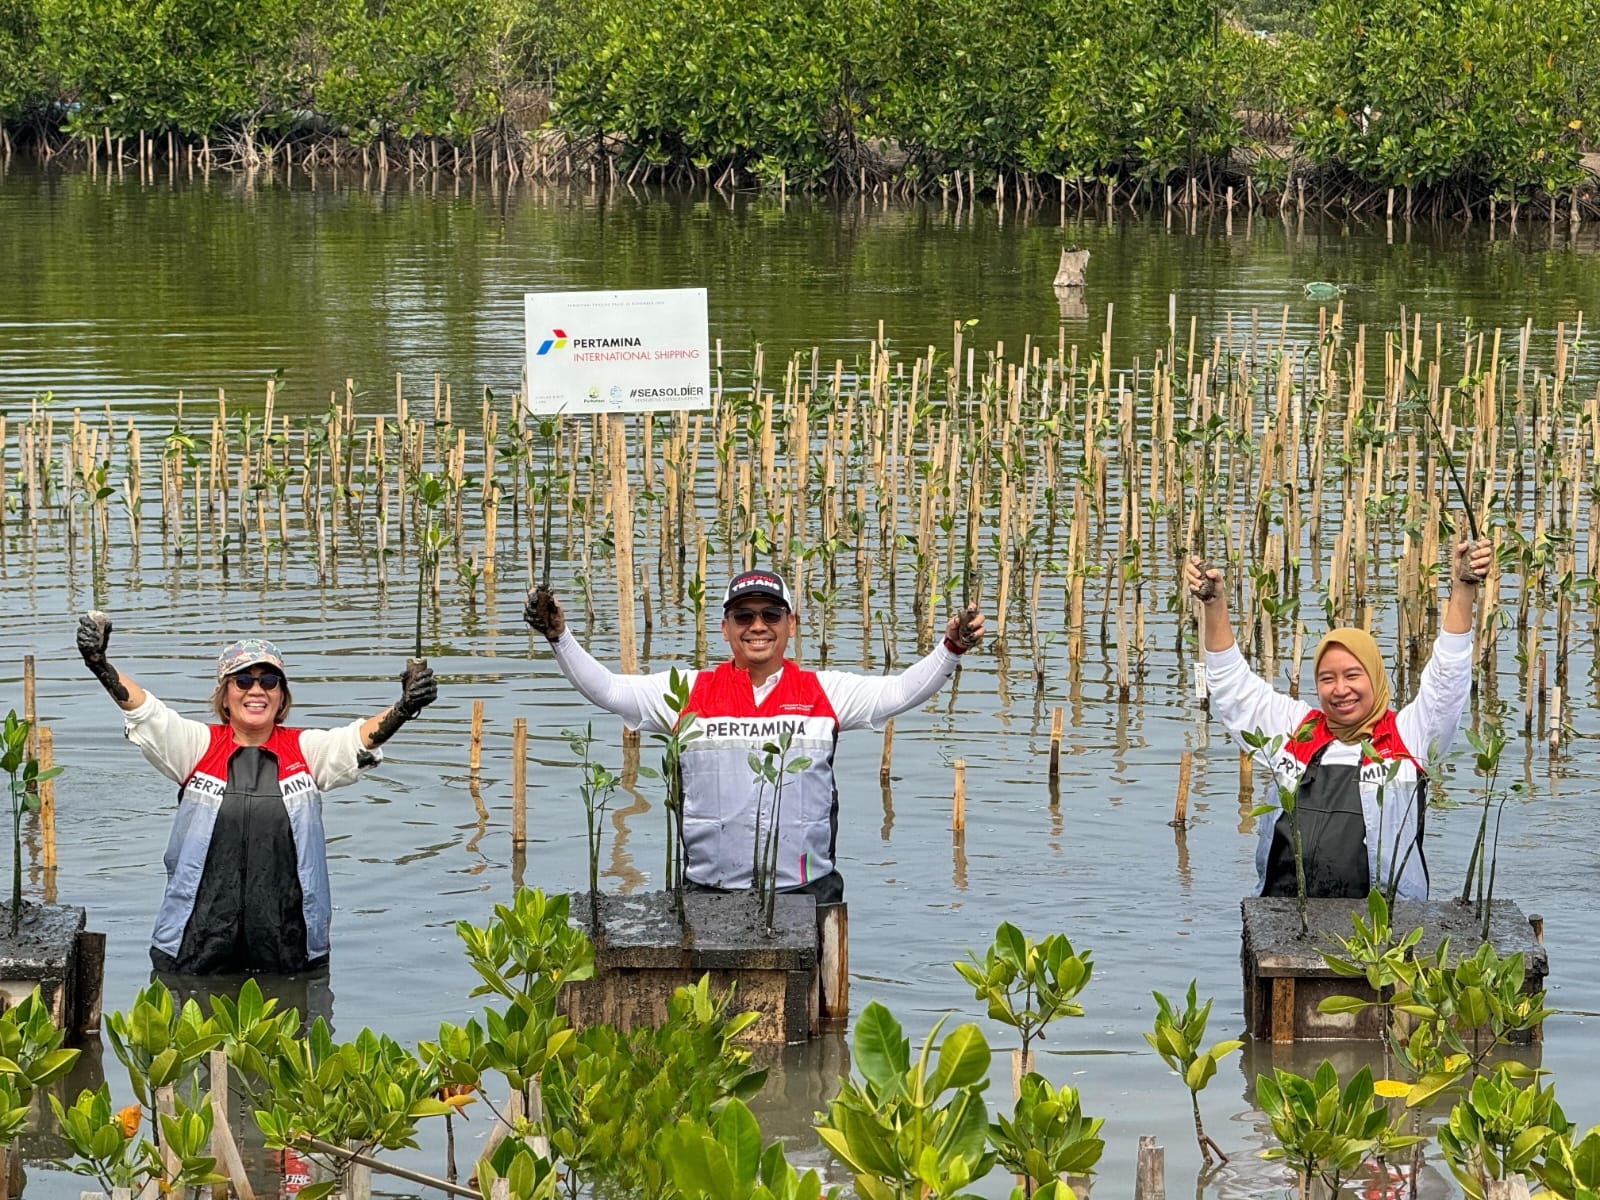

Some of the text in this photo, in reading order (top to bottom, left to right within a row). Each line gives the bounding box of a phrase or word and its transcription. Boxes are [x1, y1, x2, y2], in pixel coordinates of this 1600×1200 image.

[573, 337, 642, 349] PERTAMINA
[573, 349, 700, 362] INTERNATIONAL SHIPPING
[630, 385, 704, 398] #SEASOLDIER
[731, 579, 780, 592] TEXANS
[706, 720, 806, 737] PERTAMINA
